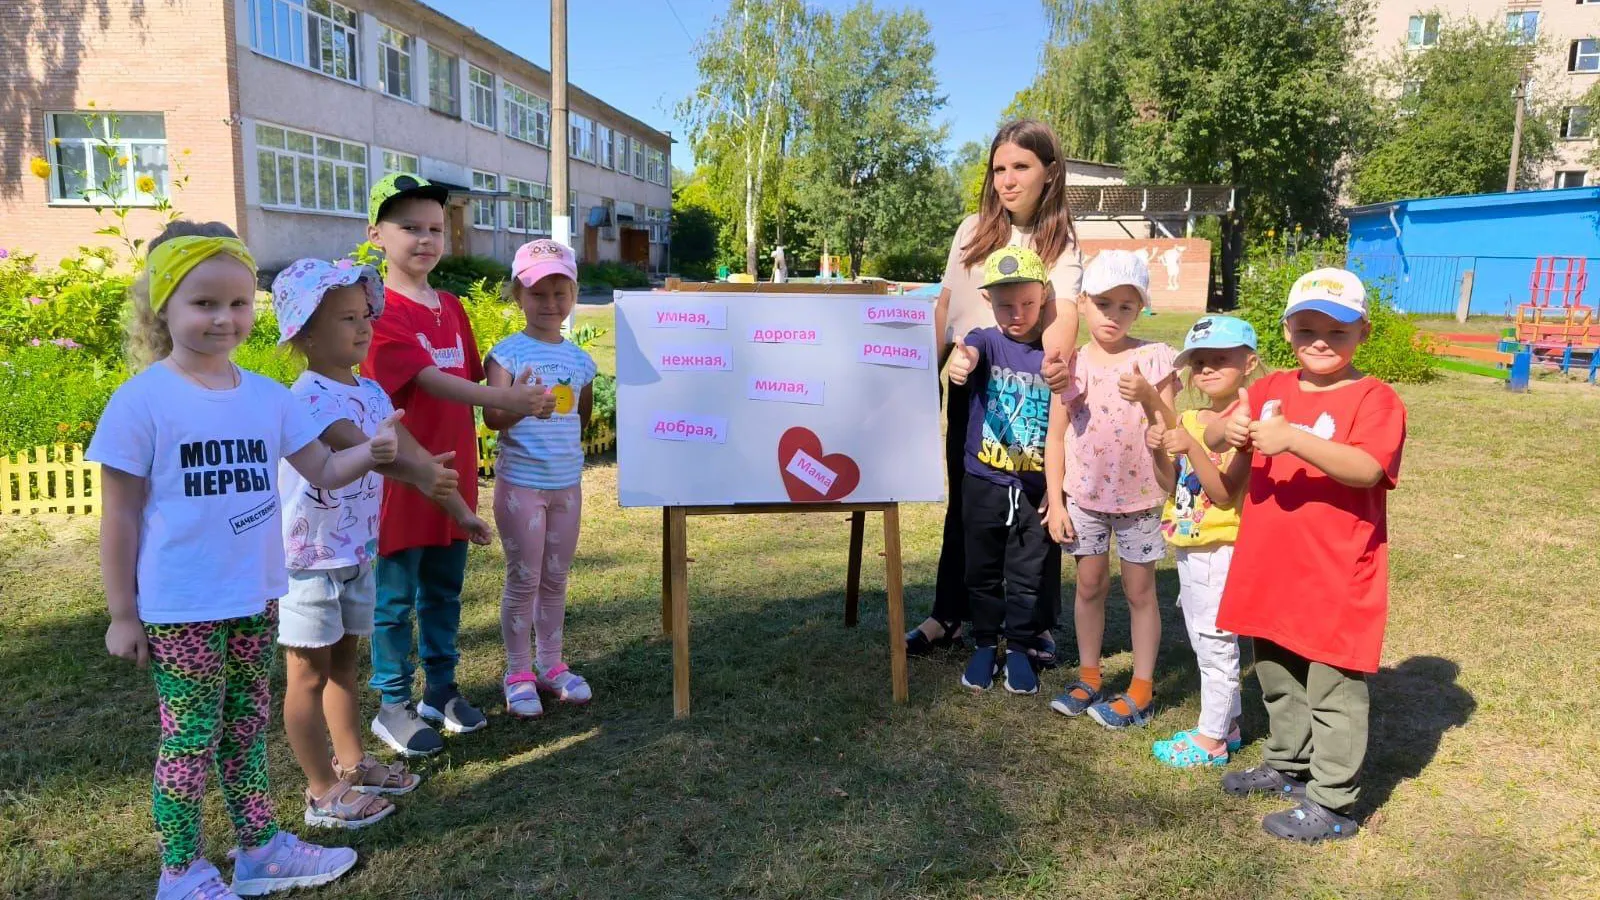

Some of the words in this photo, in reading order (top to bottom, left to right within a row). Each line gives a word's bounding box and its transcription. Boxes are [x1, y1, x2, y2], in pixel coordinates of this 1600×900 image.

[656, 309, 711, 326] умная,
[867, 306, 926, 321] близкая
[753, 328, 816, 343] дорогая
[863, 342, 922, 360] родная,
[662, 354, 727, 369] нежная,
[754, 378, 809, 395] милая,
[1020, 398, 1049, 421] BE
[654, 419, 718, 440] добрая,
[180, 439, 268, 468] МОТАЮ
[796, 456, 832, 487] Мама
[184, 467, 271, 497] НЕРВЫ
